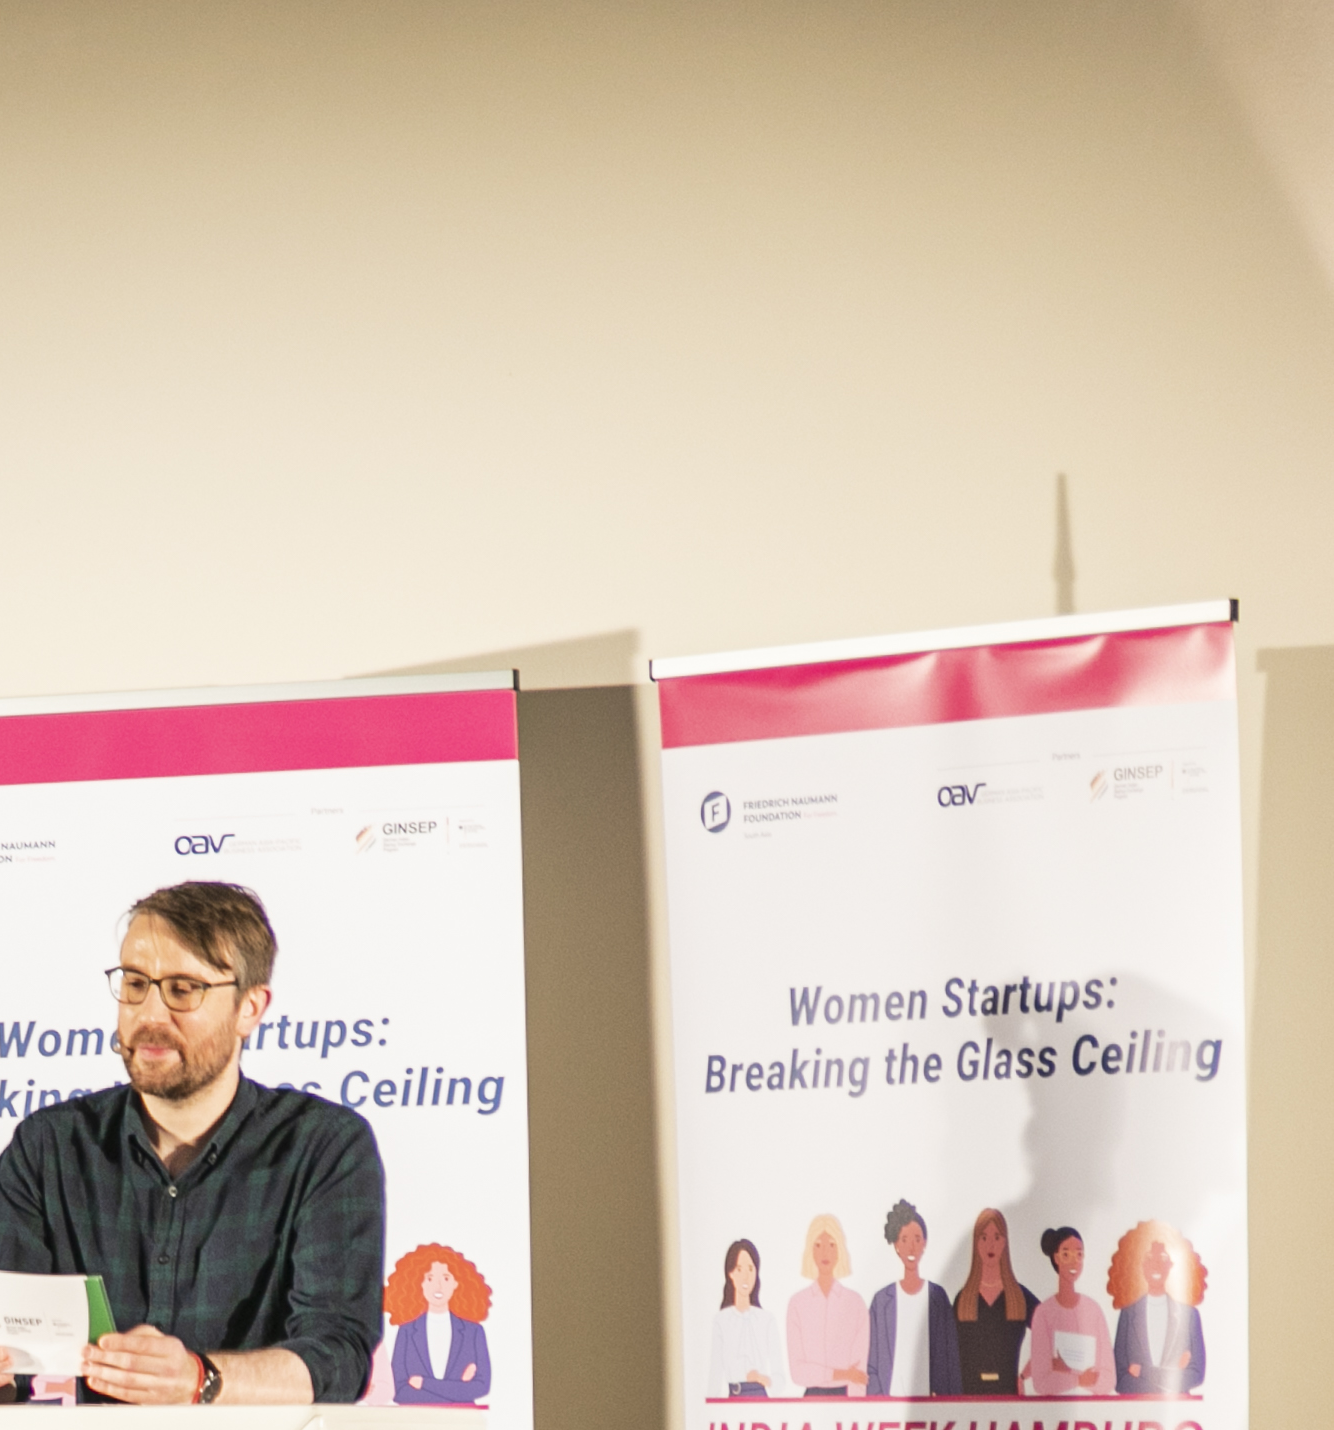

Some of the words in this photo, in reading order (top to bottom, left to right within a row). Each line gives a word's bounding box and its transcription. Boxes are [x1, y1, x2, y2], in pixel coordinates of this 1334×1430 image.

[1114, 765, 1163, 781] GINSEP
[743, 798, 789, 810] FRIEDRICH
[791, 795, 838, 806] NAUMANN
[743, 811, 801, 823] FOUNDATION
[382, 821, 437, 836] GINSEP
[1, 841, 56, 851] NAUMANN
[790, 985, 928, 1026] Women
[942, 976, 1117, 1023] Startups:
[242, 1015, 390, 1059] rtups:
[705, 1048, 870, 1098] Breaking
[885, 1042, 942, 1085] the
[957, 1037, 1058, 1082] Glass
[1072, 1029, 1223, 1082] Ceiling
[340, 1066, 505, 1115] Ceiling
